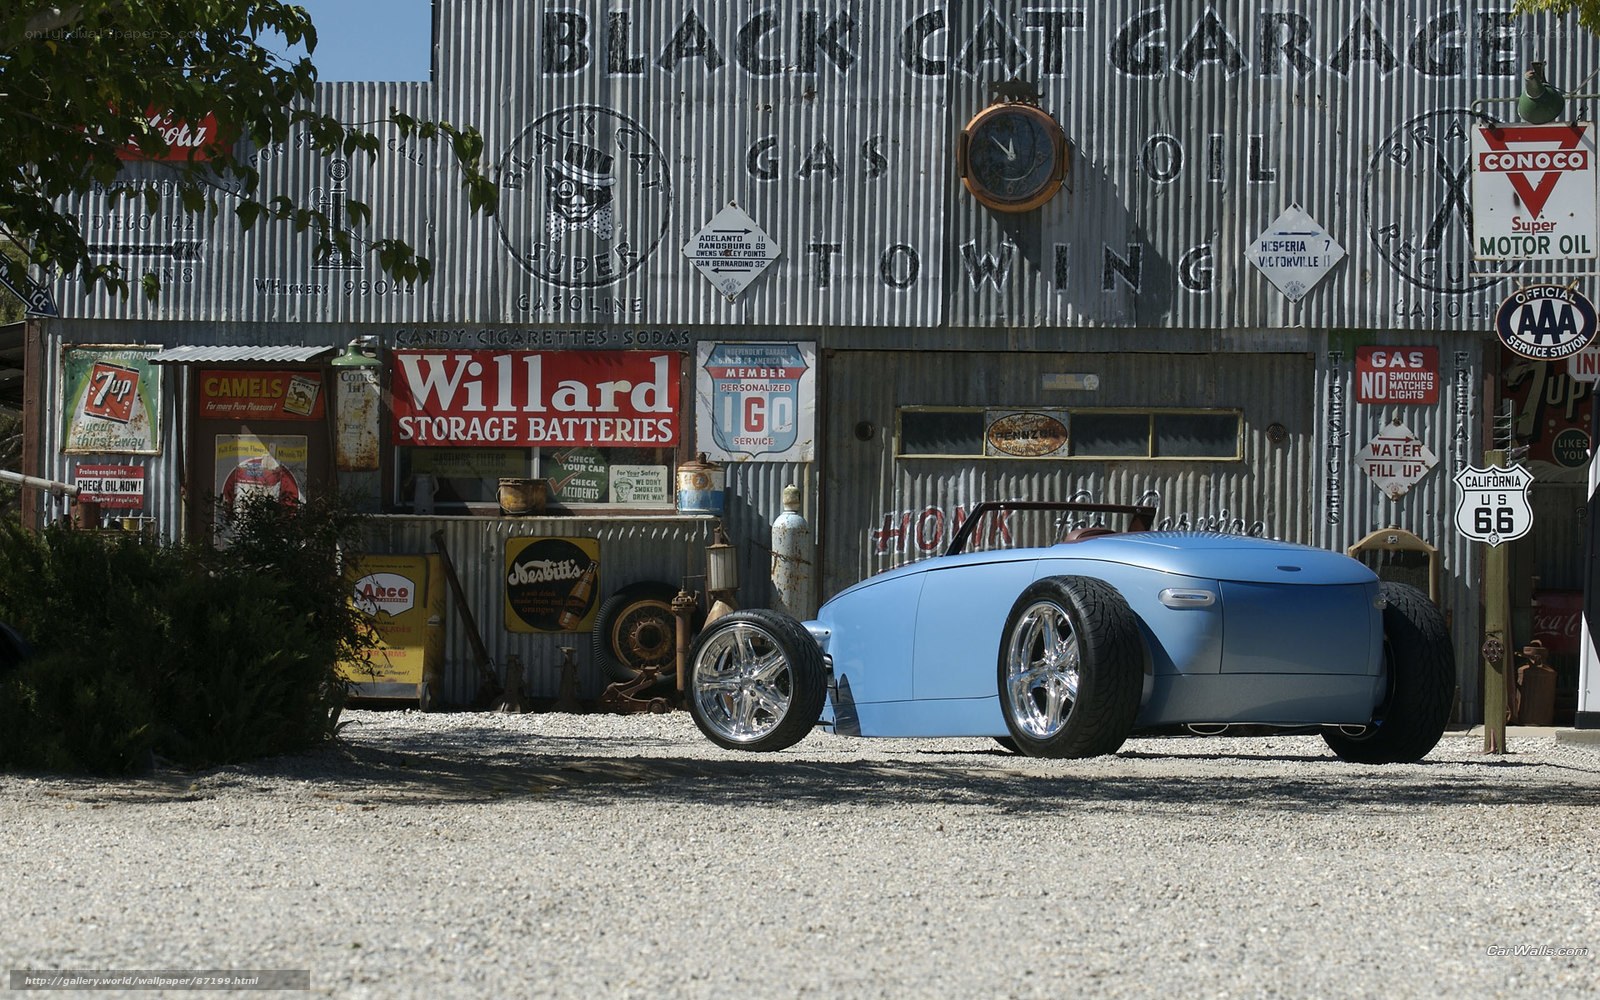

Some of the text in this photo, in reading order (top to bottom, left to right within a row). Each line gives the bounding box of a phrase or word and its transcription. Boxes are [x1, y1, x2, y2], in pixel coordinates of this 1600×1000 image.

[542, 4, 1518, 81] BLACK CAT GARAGE
[1386, 116, 1469, 167] BRA
[249, 138, 426, 168] FOR CALL
[503, 113, 664, 193] BLACK CAT
[746, 132, 1277, 184] GAS OIL
[1483, 152, 1584, 170] CONOCO
[93, 214, 150, 231] DIEGO
[163, 214, 195, 231] 142
[1512, 217, 1557, 234] Super
[698, 242, 751, 250] RANDSBURG
[1261, 240, 1331, 252] HESPERIA 7
[1378, 222, 1507, 284] REGUL
[1479, 236, 1591, 255] MOTOR OIL
[526, 240, 638, 279] SUPER
[712, 260, 754, 268] BERNARDINO
[755, 260, 766, 268] 32
[805, 239, 1215, 294] TOWING
[1259, 256, 1319, 268] VICTORVILLE
[183, 267, 194, 283] 8
[343, 279, 416, 298] 99044
[1515, 286, 1577, 304] OFFICIAL
[515, 294, 643, 314] GASOLINE
[1394, 300, 1499, 319] GASOLI
[1517, 299, 1578, 344] AAA
[396, 327, 690, 346] CANDY CIGARETTES SODAS
[1506, 333, 1588, 358] SERVICE STATION
[725, 348, 788, 356] INDEPENDENT GARAGE
[1372, 351, 1424, 368] GAS
[1577, 353, 1600, 374] IN
[341, 371, 374, 382] Come
[725, 368, 786, 378] MEMBER
[204, 377, 284, 398] CAMELS
[292, 381, 314, 392] CAMEL
[397, 354, 673, 413] Willard
[720, 383, 791, 392] PERSONALIZED
[1327, 351, 1343, 432] TIRES
[1361, 372, 1434, 399] NO SMOKING
[1389, 381, 1434, 390] MATCHES
[1453, 351, 1469, 415] FREE
[1389, 390, 1424, 399] LIGHTS
[205, 401, 277, 411] For more Pure Pleasure!
[723, 396, 793, 433] IGO
[399, 416, 673, 442] STORAGE BATTERIES
[114, 436, 145, 448] away
[734, 437, 774, 445] SERVICE
[1558, 439, 1588, 448] LIKES
[568, 455, 595, 464] CHECK
[1371, 444, 1422, 457] WATER
[1563, 451, 1584, 460] YOU
[562, 464, 605, 473] YOUR CAR
[1369, 464, 1421, 477] FILL UP
[78, 480, 142, 492] CHECK OIL NOW!
[571, 478, 598, 487] CHECK
[1327, 444, 1342, 525] TUBES
[1465, 475, 1521, 488] CALIFORNIA
[562, 487, 599, 499] ACCIDENTS
[870, 497, 1017, 556] HONK
[1474, 507, 1514, 533] 66
[508, 558, 581, 585] Nesbitt's
